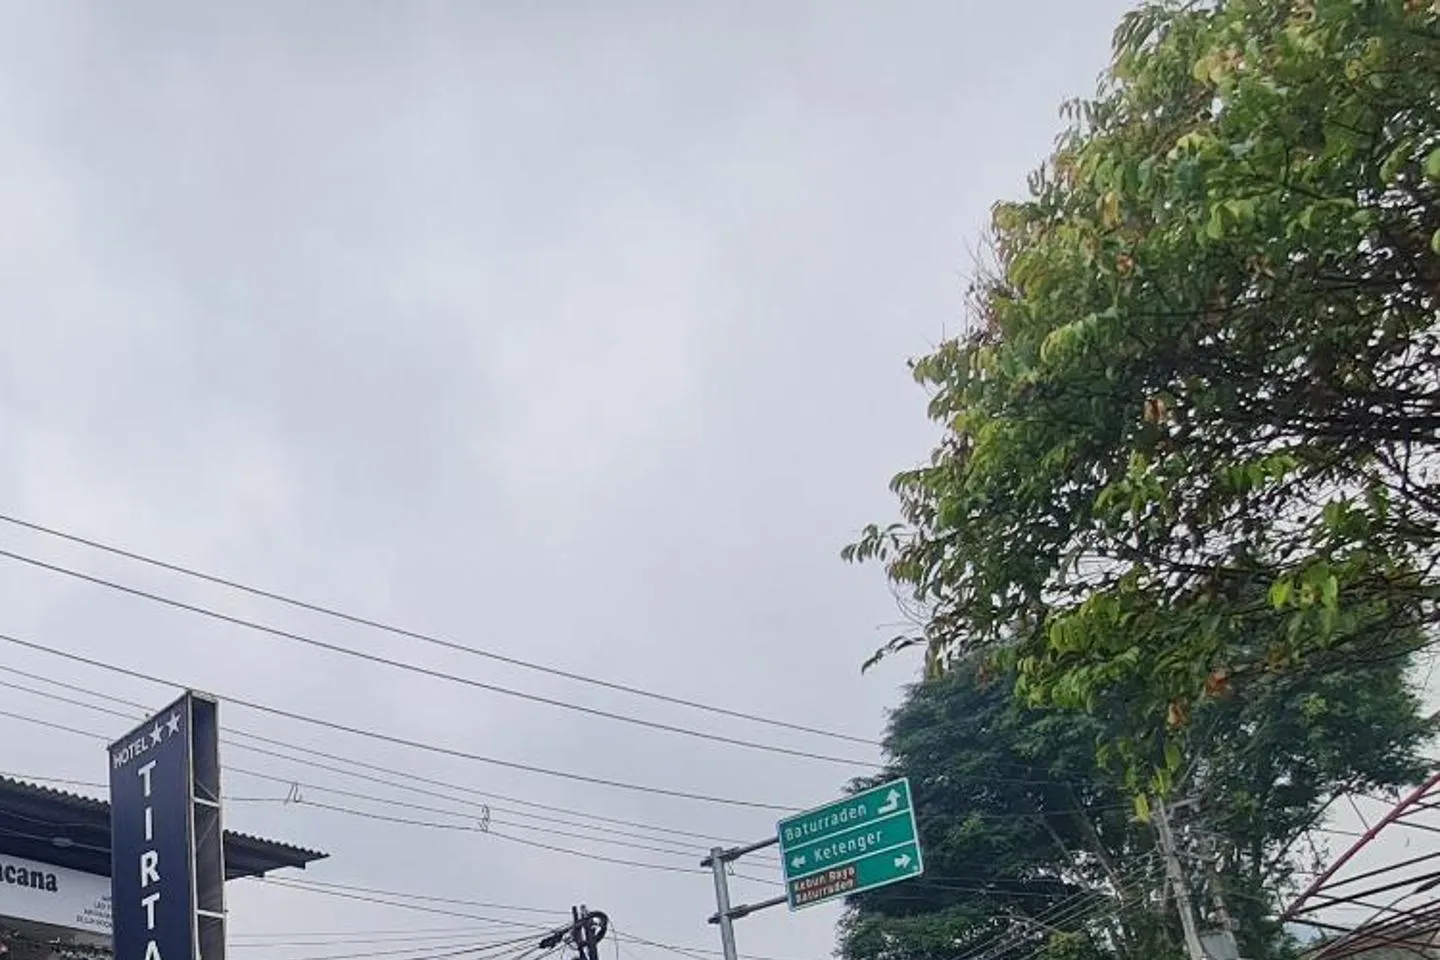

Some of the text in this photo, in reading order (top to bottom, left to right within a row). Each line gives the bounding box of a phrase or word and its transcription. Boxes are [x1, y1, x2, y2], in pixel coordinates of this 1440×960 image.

[113, 732, 147, 769] HOTEL
[784, 803, 868, 842] Baturraden
[813, 829, 883, 863] Ketenger
